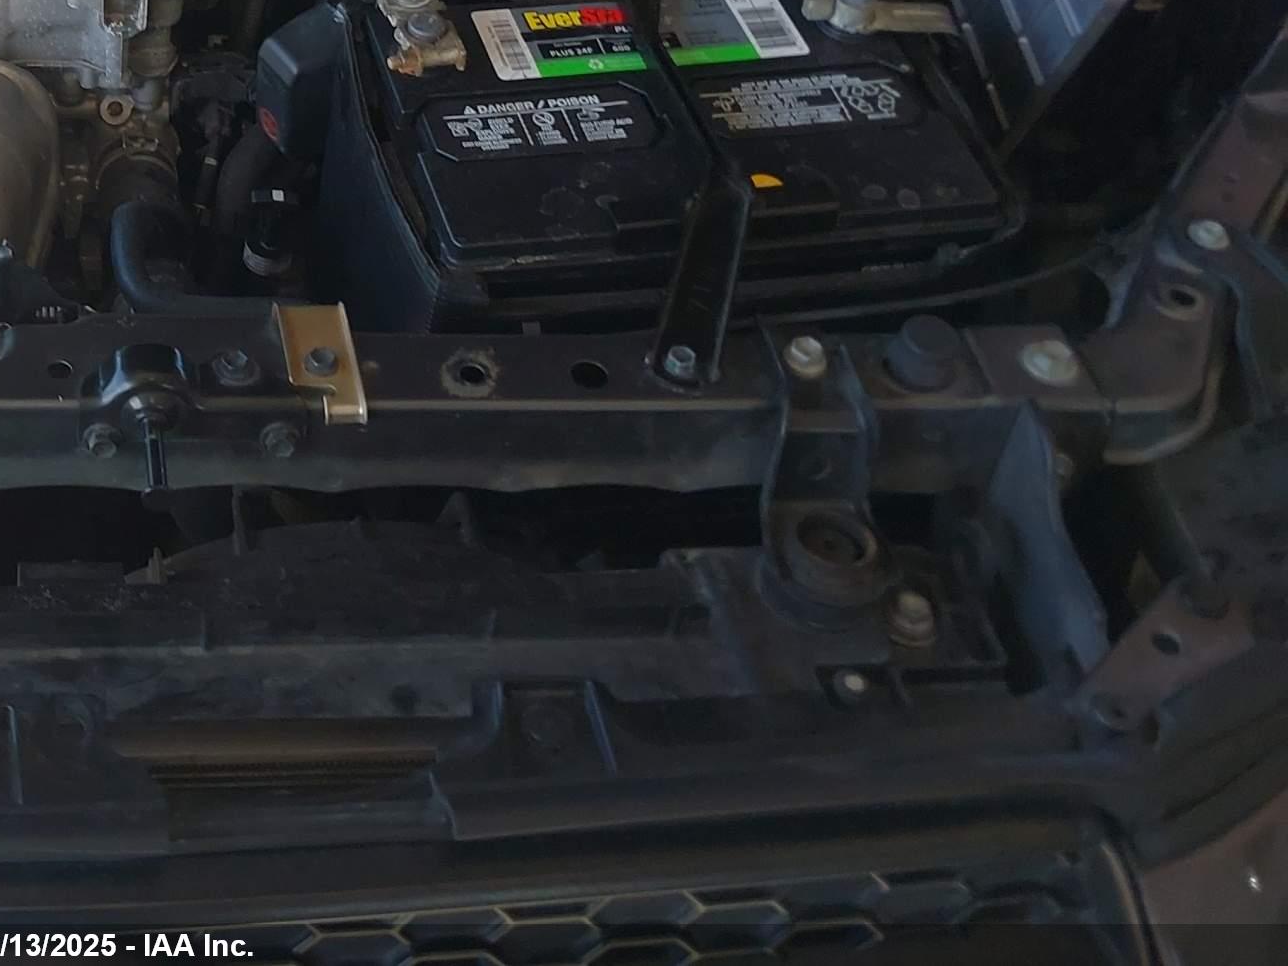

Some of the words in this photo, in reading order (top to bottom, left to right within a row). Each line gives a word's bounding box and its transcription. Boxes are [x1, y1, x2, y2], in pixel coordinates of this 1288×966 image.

[523, 4, 626, 31] EverSta
[549, 48, 575, 58] PLUS
[477, 100, 534, 115] DANGER
[547, 94, 600, 111] POISON
